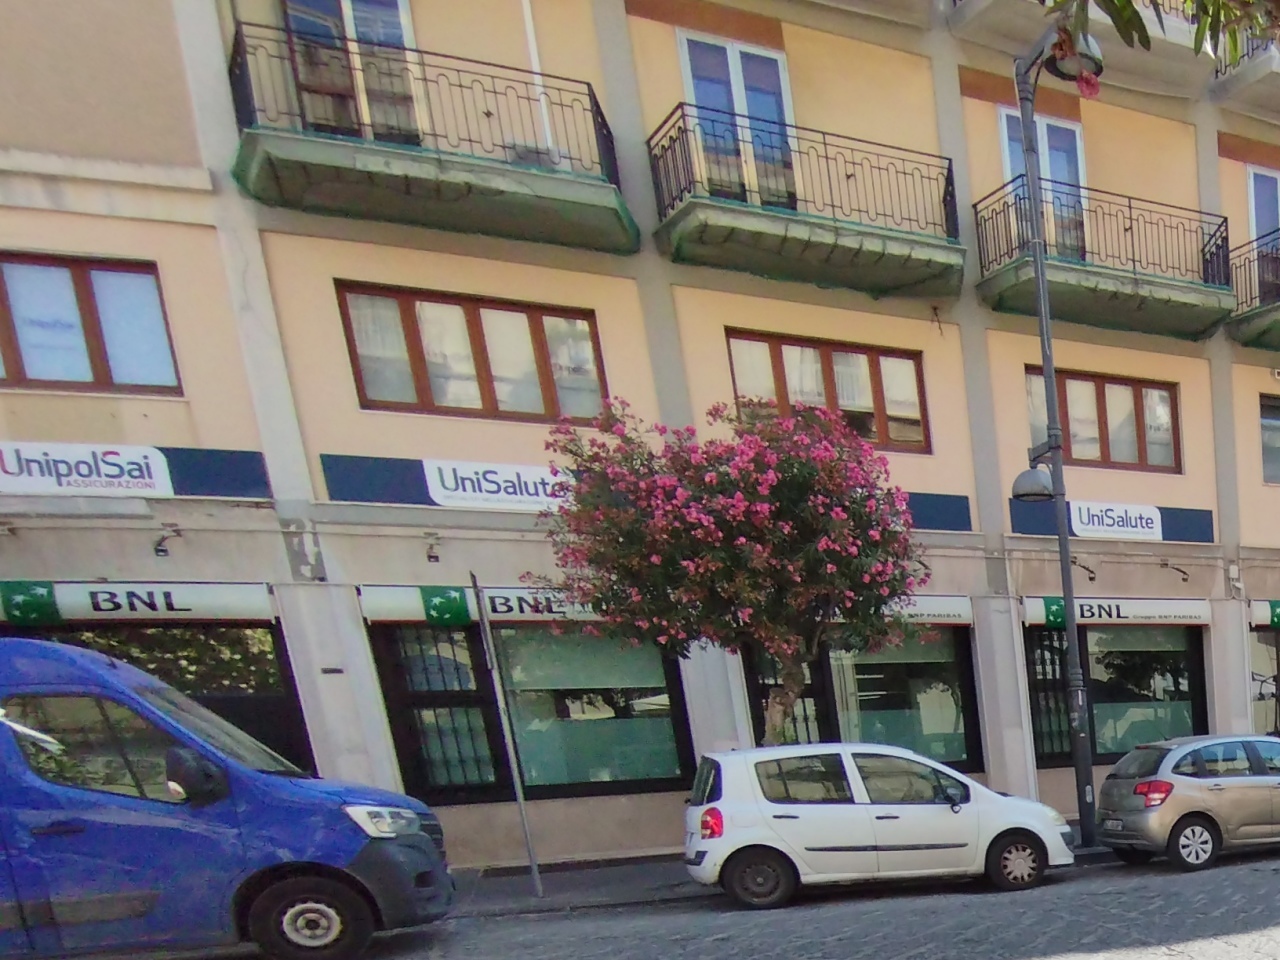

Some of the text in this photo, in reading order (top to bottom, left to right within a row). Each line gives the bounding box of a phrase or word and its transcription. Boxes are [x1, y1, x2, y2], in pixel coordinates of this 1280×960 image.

[0, 449, 153, 487] UnipolSai
[65, 480, 156, 490] ASSICURAZIONI
[1078, 506, 1155, 529] UniSalute
[89, 591, 193, 612] BNL
[488, 595, 566, 614] BNL
[1079, 603, 1129, 619] BNL
